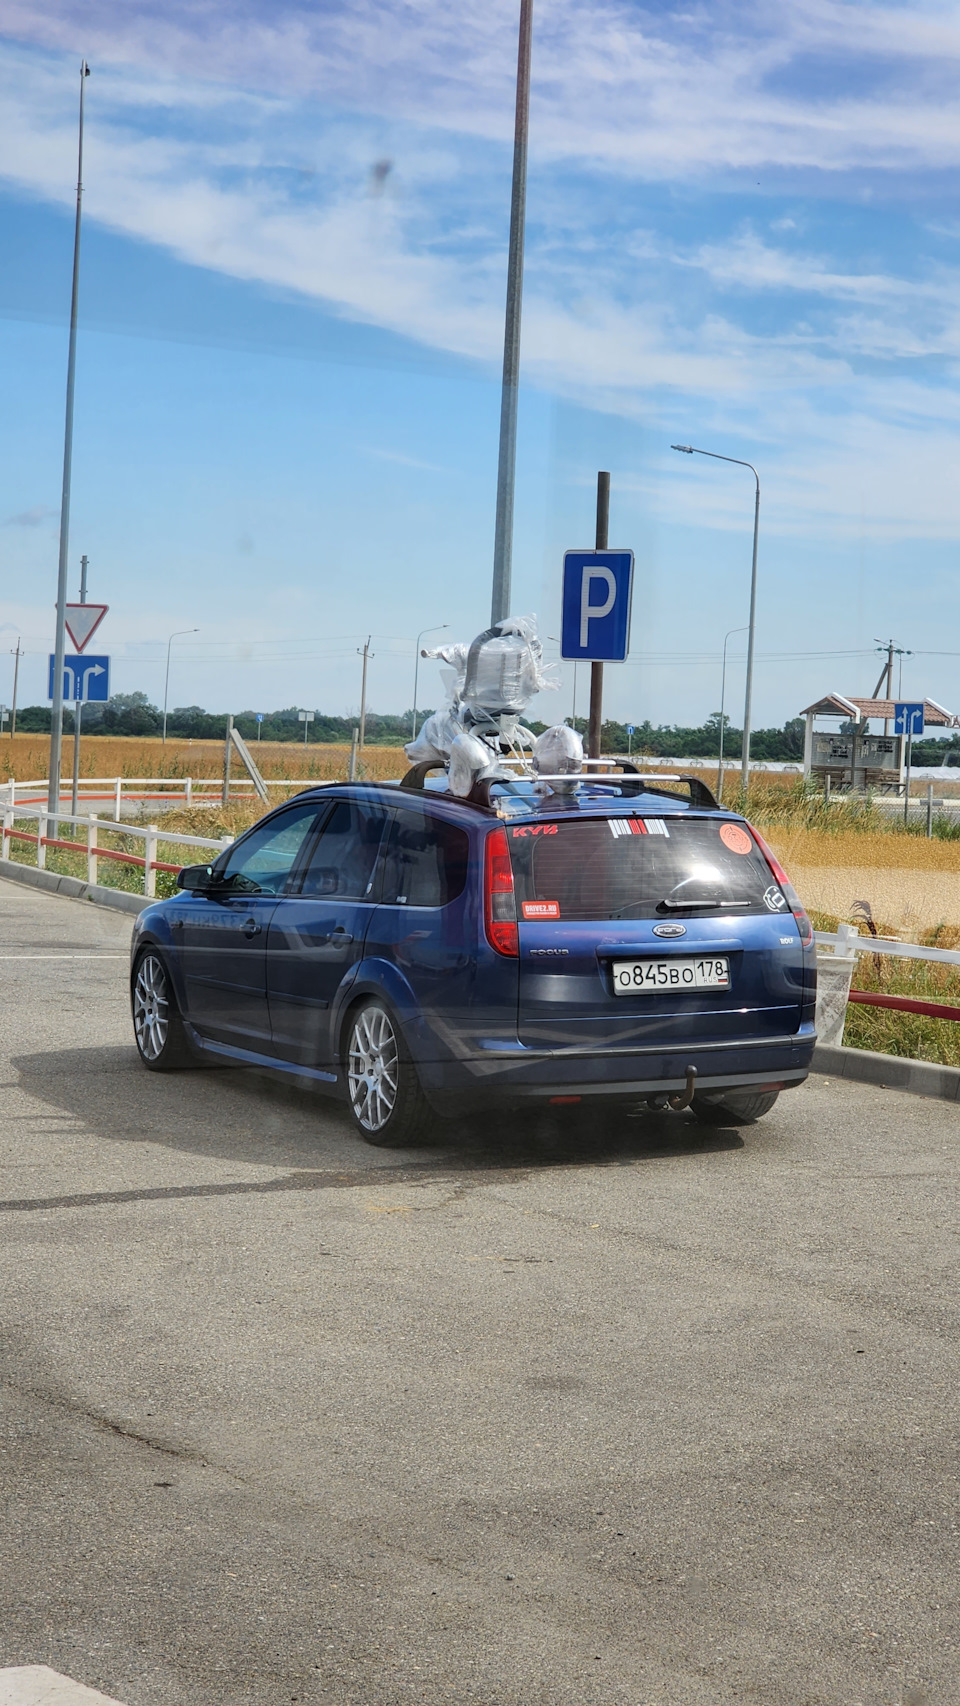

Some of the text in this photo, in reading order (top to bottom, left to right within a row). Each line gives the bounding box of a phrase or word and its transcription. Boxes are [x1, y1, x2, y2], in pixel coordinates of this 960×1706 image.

[580, 565, 617, 648] P
[525, 904, 557, 912] DRIVE2.RU
[529, 948, 569, 956] FOCUS
[619, 961, 724, 986] О845ВО 178
[703, 976, 718, 984] RUS
